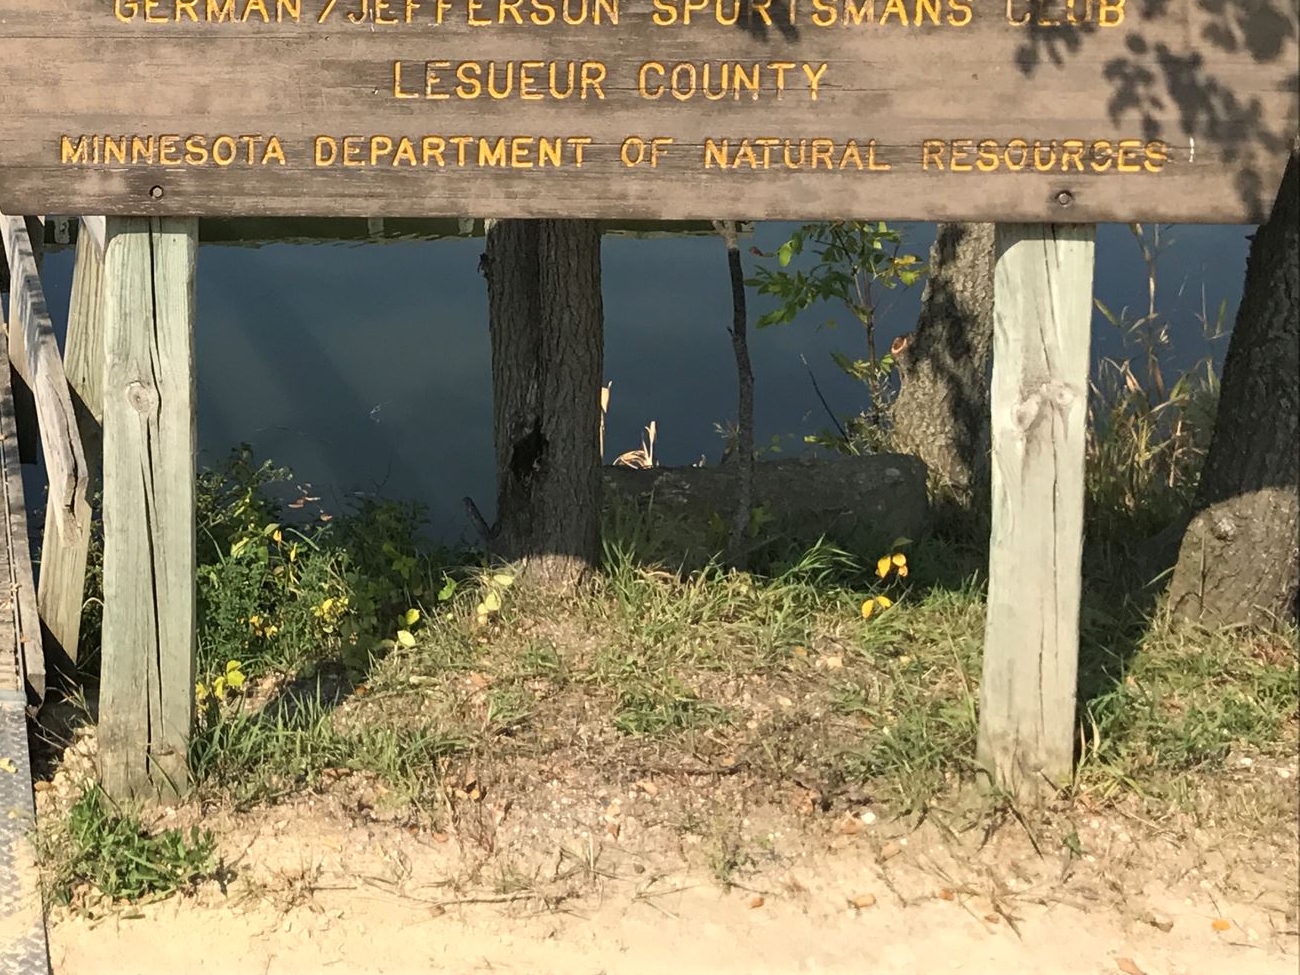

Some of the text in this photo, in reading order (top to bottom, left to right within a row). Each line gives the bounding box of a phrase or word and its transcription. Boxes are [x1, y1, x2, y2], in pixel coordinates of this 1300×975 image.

[392, 60, 828, 101] LESUEUR COUNTY
[59, 134, 1170, 172] MINNESOTA DEPARTMENT OF NATURAL RESOURCES
